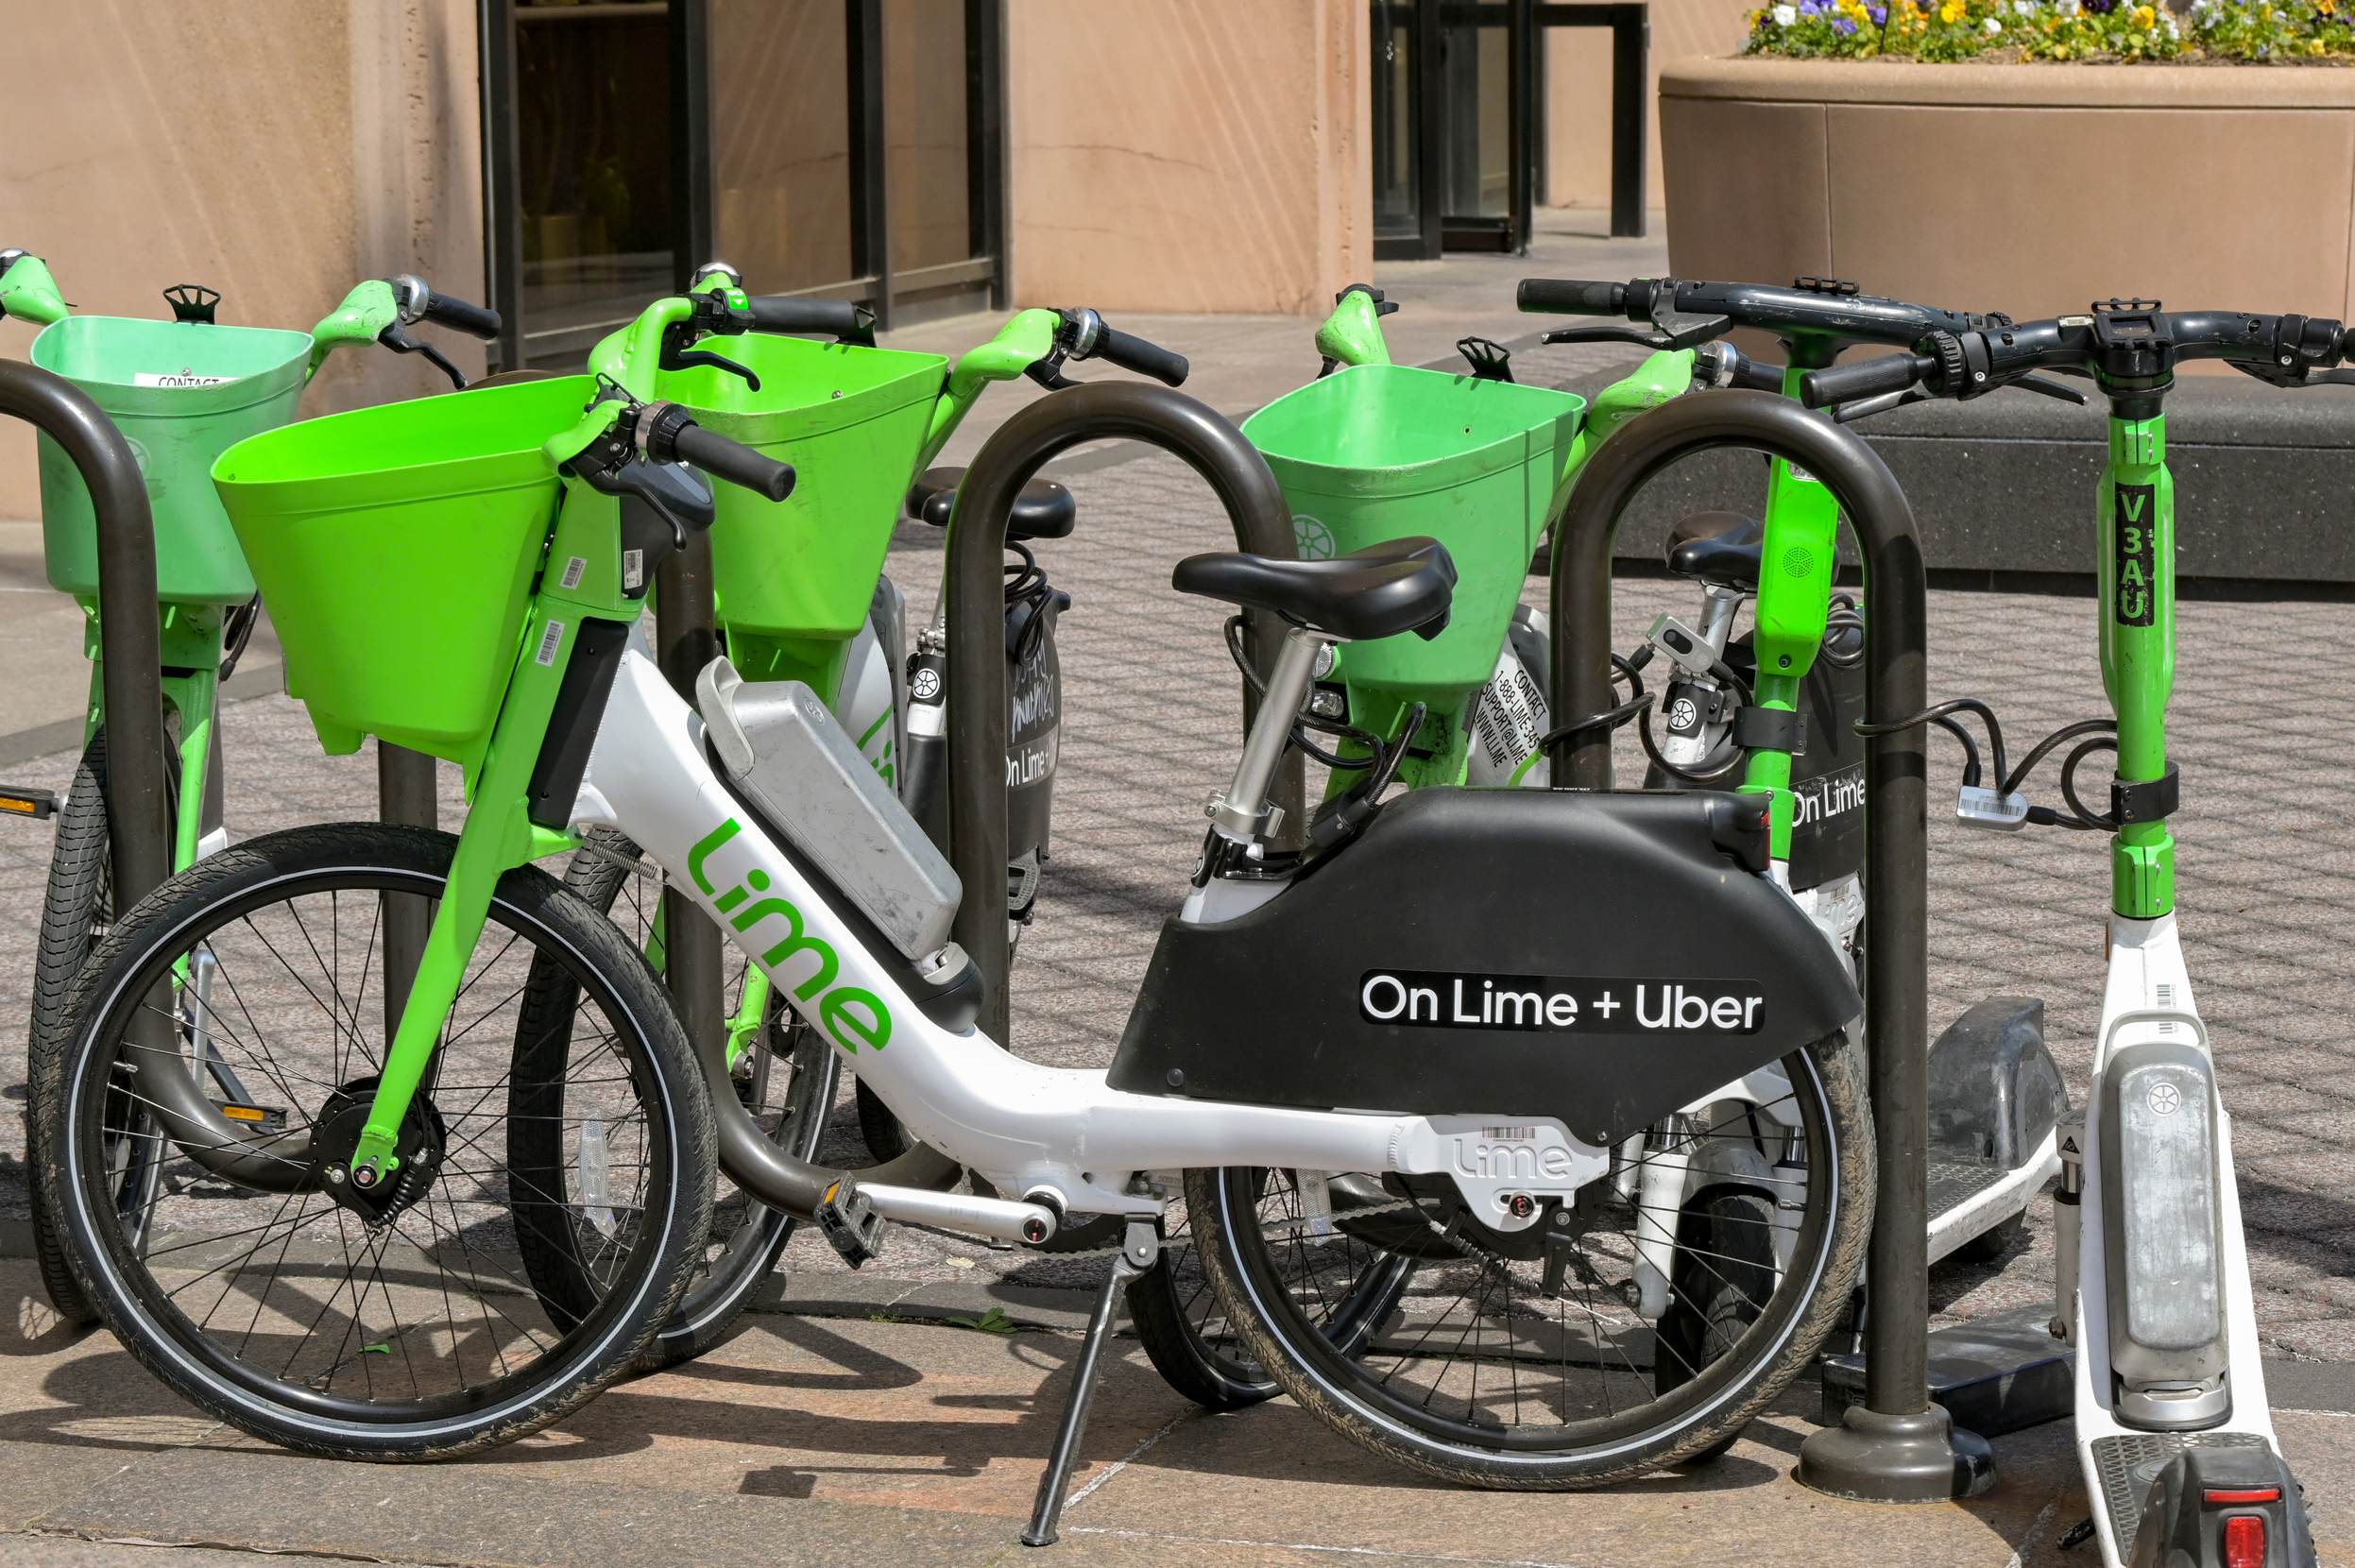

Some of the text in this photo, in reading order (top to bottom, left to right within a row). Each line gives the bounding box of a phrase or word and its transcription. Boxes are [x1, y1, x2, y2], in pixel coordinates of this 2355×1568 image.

[158, 376, 219, 386] CONTA
[2122, 494, 2145, 618] V3AU
[1494, 670, 1541, 749] 1-888-LIME-345
[1513, 669, 1547, 721] CONTACT
[1476, 707, 1508, 768] WWW.LI.ME
[1482, 682, 1528, 766] SUPPORT@LI.ME
[1022, 747, 1045, 784] Lime
[1824, 778, 1866, 818] Lime
[688, 817, 893, 1056] Lime
[1362, 975, 1763, 1029] On Lime + Uber
[1453, 1138, 1573, 1180] Lime
